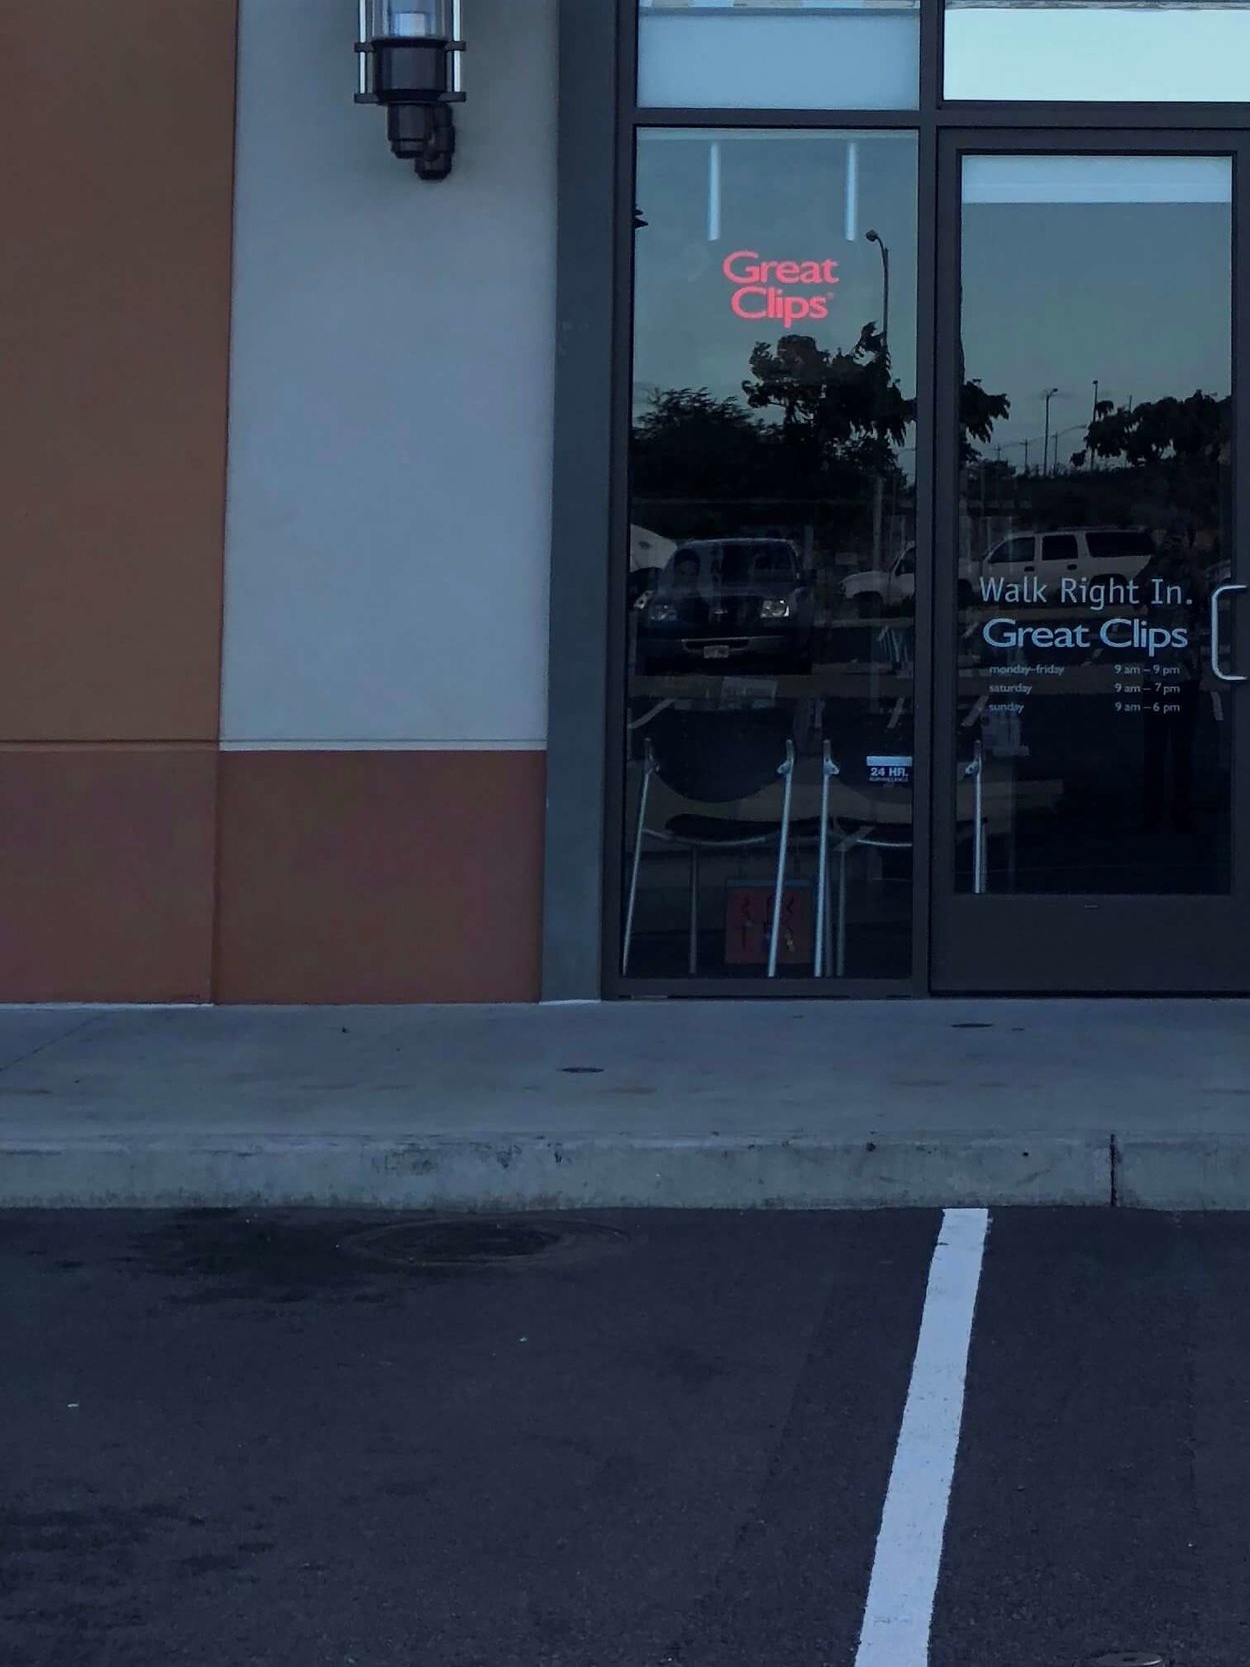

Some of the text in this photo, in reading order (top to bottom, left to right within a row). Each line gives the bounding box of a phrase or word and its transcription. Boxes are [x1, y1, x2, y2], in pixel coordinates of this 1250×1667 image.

[723, 250, 839, 284] Great
[731, 286, 829, 328] Clips
[980, 577, 1193, 611] Walk Right In.
[983, 617, 1188, 657] Great Clips
[1114, 664, 1122, 674] 9
[1124, 666, 1141, 675] am
[1153, 664, 1160, 674] 9
[1162, 666, 1180, 677] pm
[988, 682, 1033, 695] saturday
[1114, 683, 1122, 693] 9
[1124, 685, 1141, 694] am
[1154, 683, 1162, 693] 7
[1162, 685, 1180, 696] pm
[988, 702, 1025, 714] sunday
[1114, 702, 1122, 712] 9
[1124, 704, 1141, 712] am
[1153, 702, 1160, 712] 6
[1162, 704, 1180, 715] pm
[871, 767, 909, 776] 24 HR.
